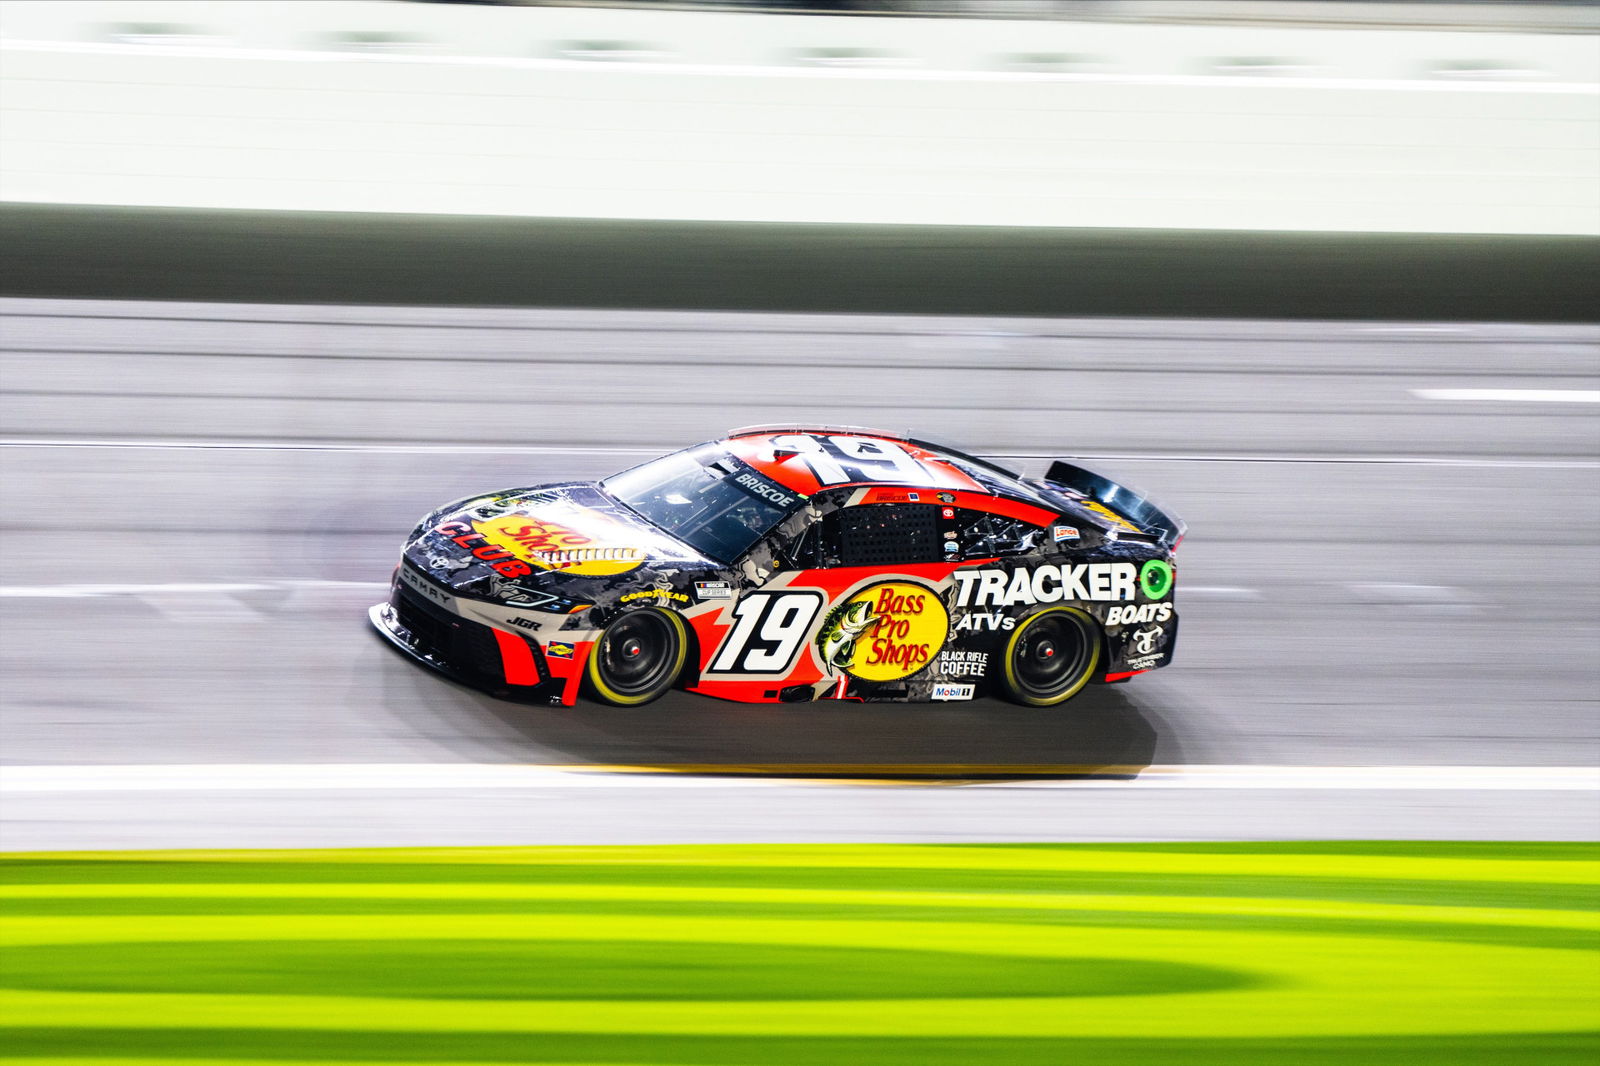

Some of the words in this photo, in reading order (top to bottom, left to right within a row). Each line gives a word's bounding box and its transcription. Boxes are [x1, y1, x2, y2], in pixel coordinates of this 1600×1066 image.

[768, 434, 935, 486] 19
[735, 473, 795, 508] BRISCOE
[434, 520, 532, 579] CLUB
[402, 567, 450, 602] CAMRY
[620, 588, 689, 603] GOODYEAR
[953, 562, 1138, 606] TRACKER
[873, 588, 925, 614] Bass
[506, 616, 543, 632] JGR
[869, 614, 911, 639] Pro
[955, 613, 1016, 631] ATVs
[1105, 602, 1173, 626] BOATS
[708, 593, 822, 673] 19
[866, 638, 930, 671] Shops
[941, 651, 966, 661] BLACK
[966, 651, 989, 664] RIFLE
[940, 661, 987, 677] COFFEE
[936, 688, 961, 697] Mobil
